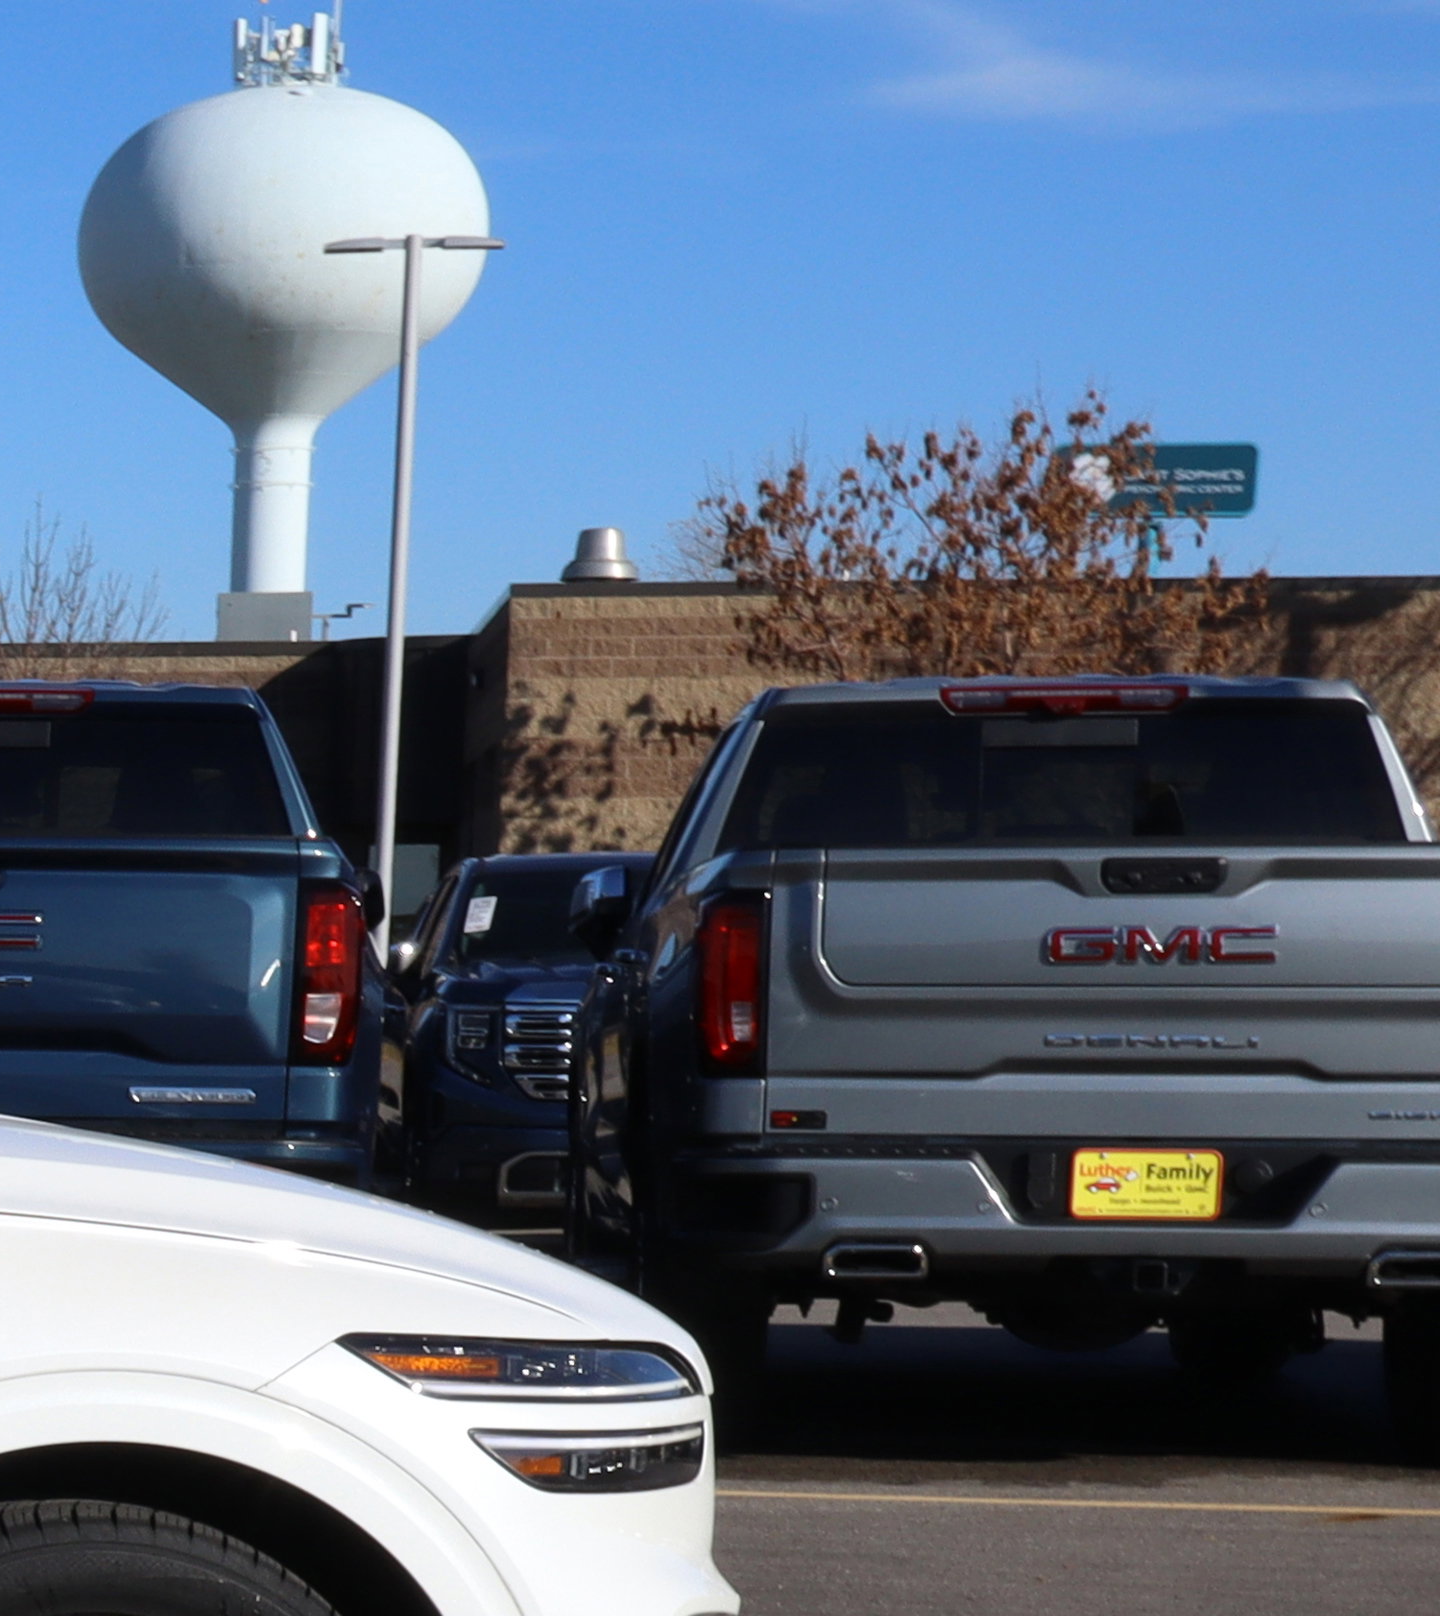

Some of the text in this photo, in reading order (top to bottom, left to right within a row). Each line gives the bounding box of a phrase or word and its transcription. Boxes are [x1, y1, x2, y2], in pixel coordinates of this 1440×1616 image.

[1040, 923, 1280, 966] GMC
[1043, 1032, 1261, 1050] DENALI
[1146, 1163, 1214, 1185] Family
